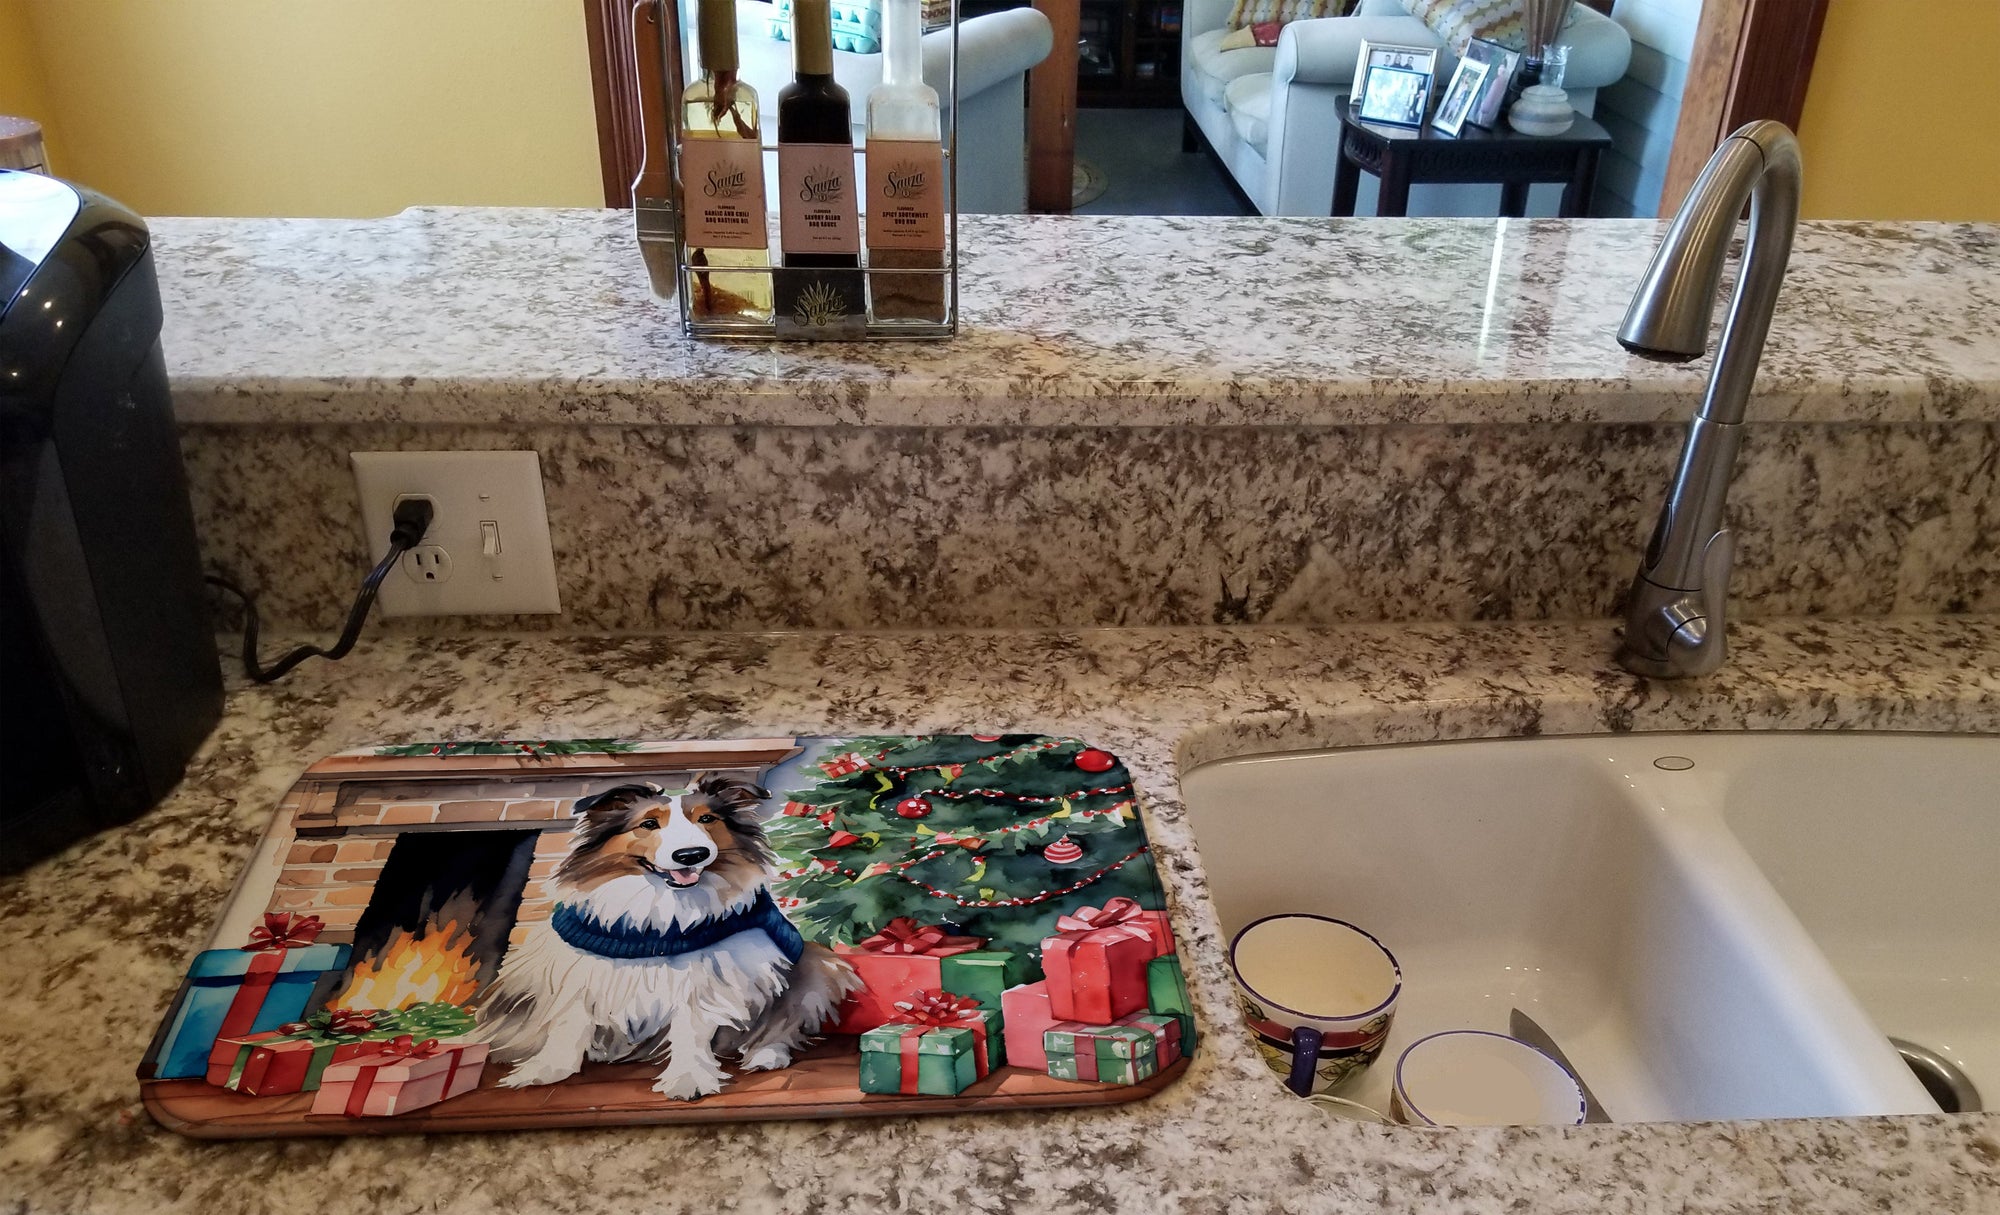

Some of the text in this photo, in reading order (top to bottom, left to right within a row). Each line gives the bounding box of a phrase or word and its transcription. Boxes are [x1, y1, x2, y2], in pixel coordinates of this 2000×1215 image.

[704, 170, 745, 197] Sauza
[800, 175, 841, 202] Sauza
[884, 171, 925, 198] Sauza
